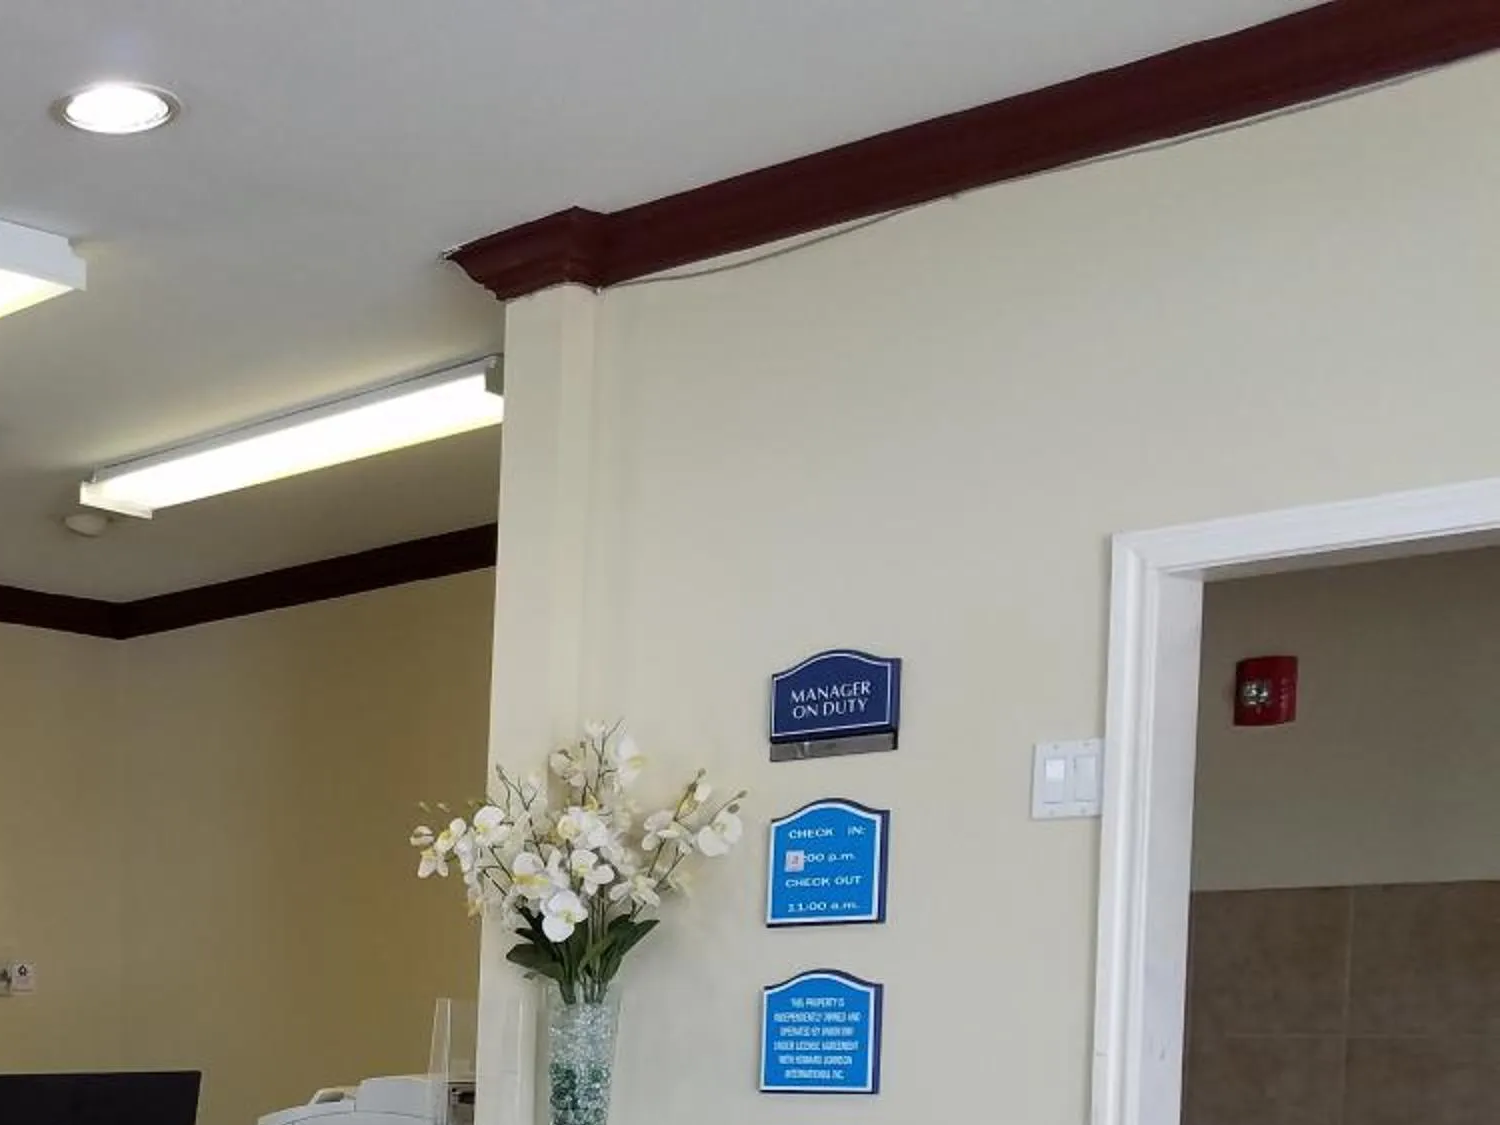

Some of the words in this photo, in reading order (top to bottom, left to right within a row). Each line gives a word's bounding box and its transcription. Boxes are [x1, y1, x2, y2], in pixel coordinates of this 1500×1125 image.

[790, 681, 872, 703] MANAGER
[793, 704, 818, 719] ON
[823, 697, 869, 716] DUTY
[788, 828, 835, 839] CHECK
[785, 877, 831, 888] CHECK
[834, 875, 862, 886] OUT
